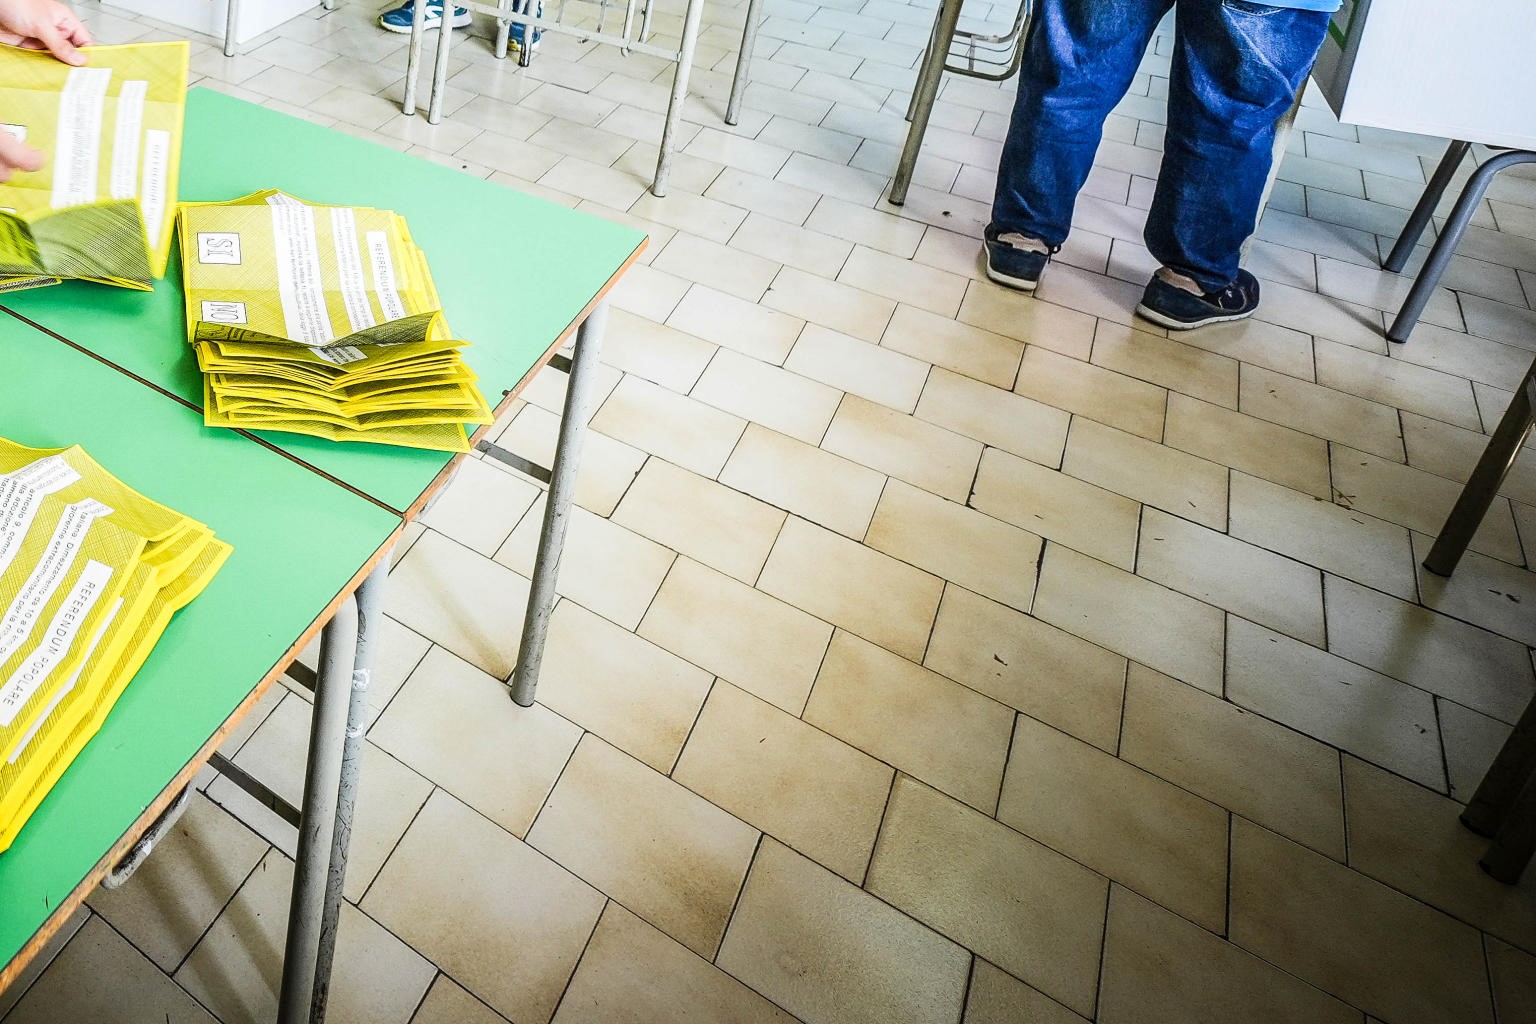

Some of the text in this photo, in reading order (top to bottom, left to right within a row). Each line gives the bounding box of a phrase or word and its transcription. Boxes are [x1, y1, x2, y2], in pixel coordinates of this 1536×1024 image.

[207, 238, 233, 256] SI
[373, 242, 389, 293] REFERENDUM
[211, 303, 239, 320] NO
[0, 478, 20, 510] almeno
[10, 519, 21, 531] 9,
[21, 538, 62, 602] extracomunitario
[37, 540, 74, 596] Dimezzamento
[13, 598, 25, 615] per
[30, 594, 42, 608] da
[8, 613, 18, 624] la
[19, 618, 27, 626] a
[23, 607, 35, 620] 10
[15, 626, 24, 636] 5
[2, 579, 96, 708] REFERENDUM POPOLARE
